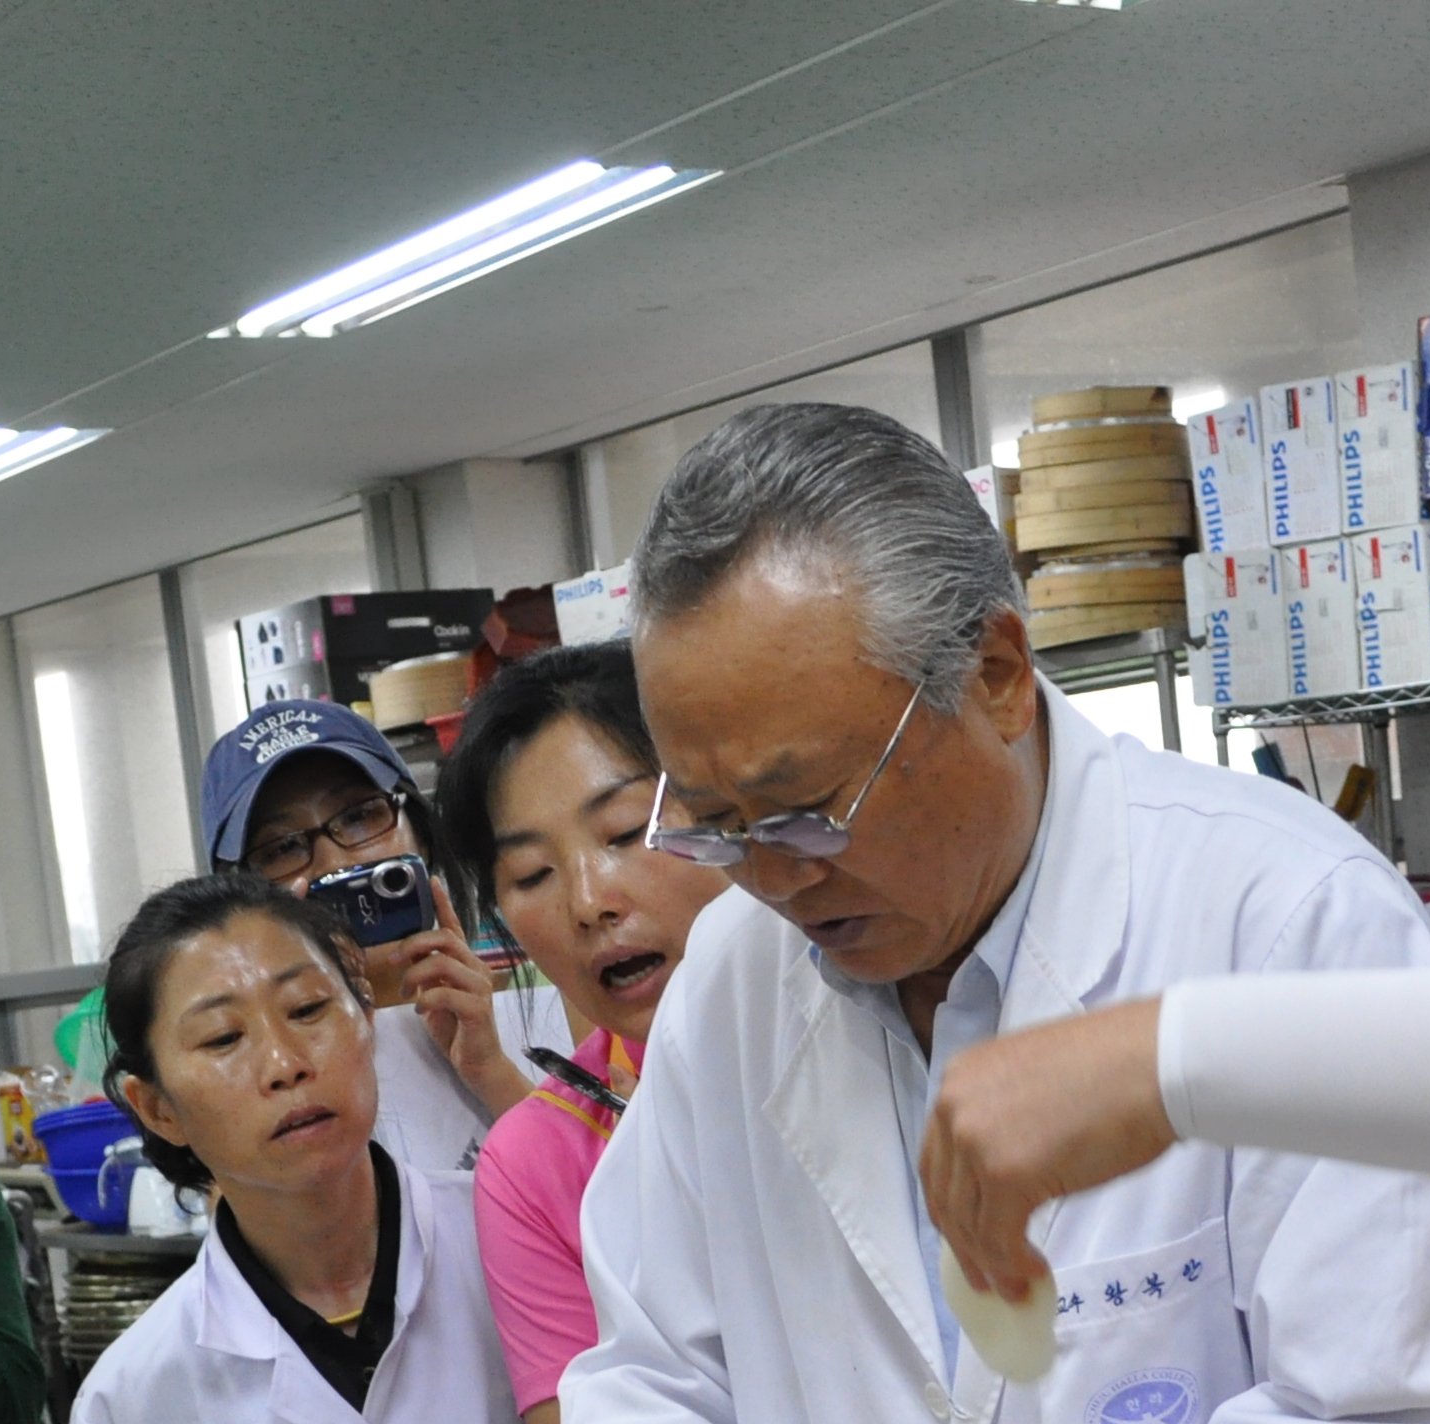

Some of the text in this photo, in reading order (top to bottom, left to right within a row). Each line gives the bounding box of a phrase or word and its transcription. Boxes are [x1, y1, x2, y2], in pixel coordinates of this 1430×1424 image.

[1272, 440, 1291, 538] PHILIPS
[1344, 429, 1365, 528] PHILIPS
[556, 577, 604, 603] PHILIPS
[1211, 609, 1232, 704] PHILIPS
[1289, 600, 1309, 695] PHILIPS
[1360, 590, 1383, 688] PHILIPS
[239, 709, 323, 751] AMERICAN
[257, 724, 311, 751] EAGLE
